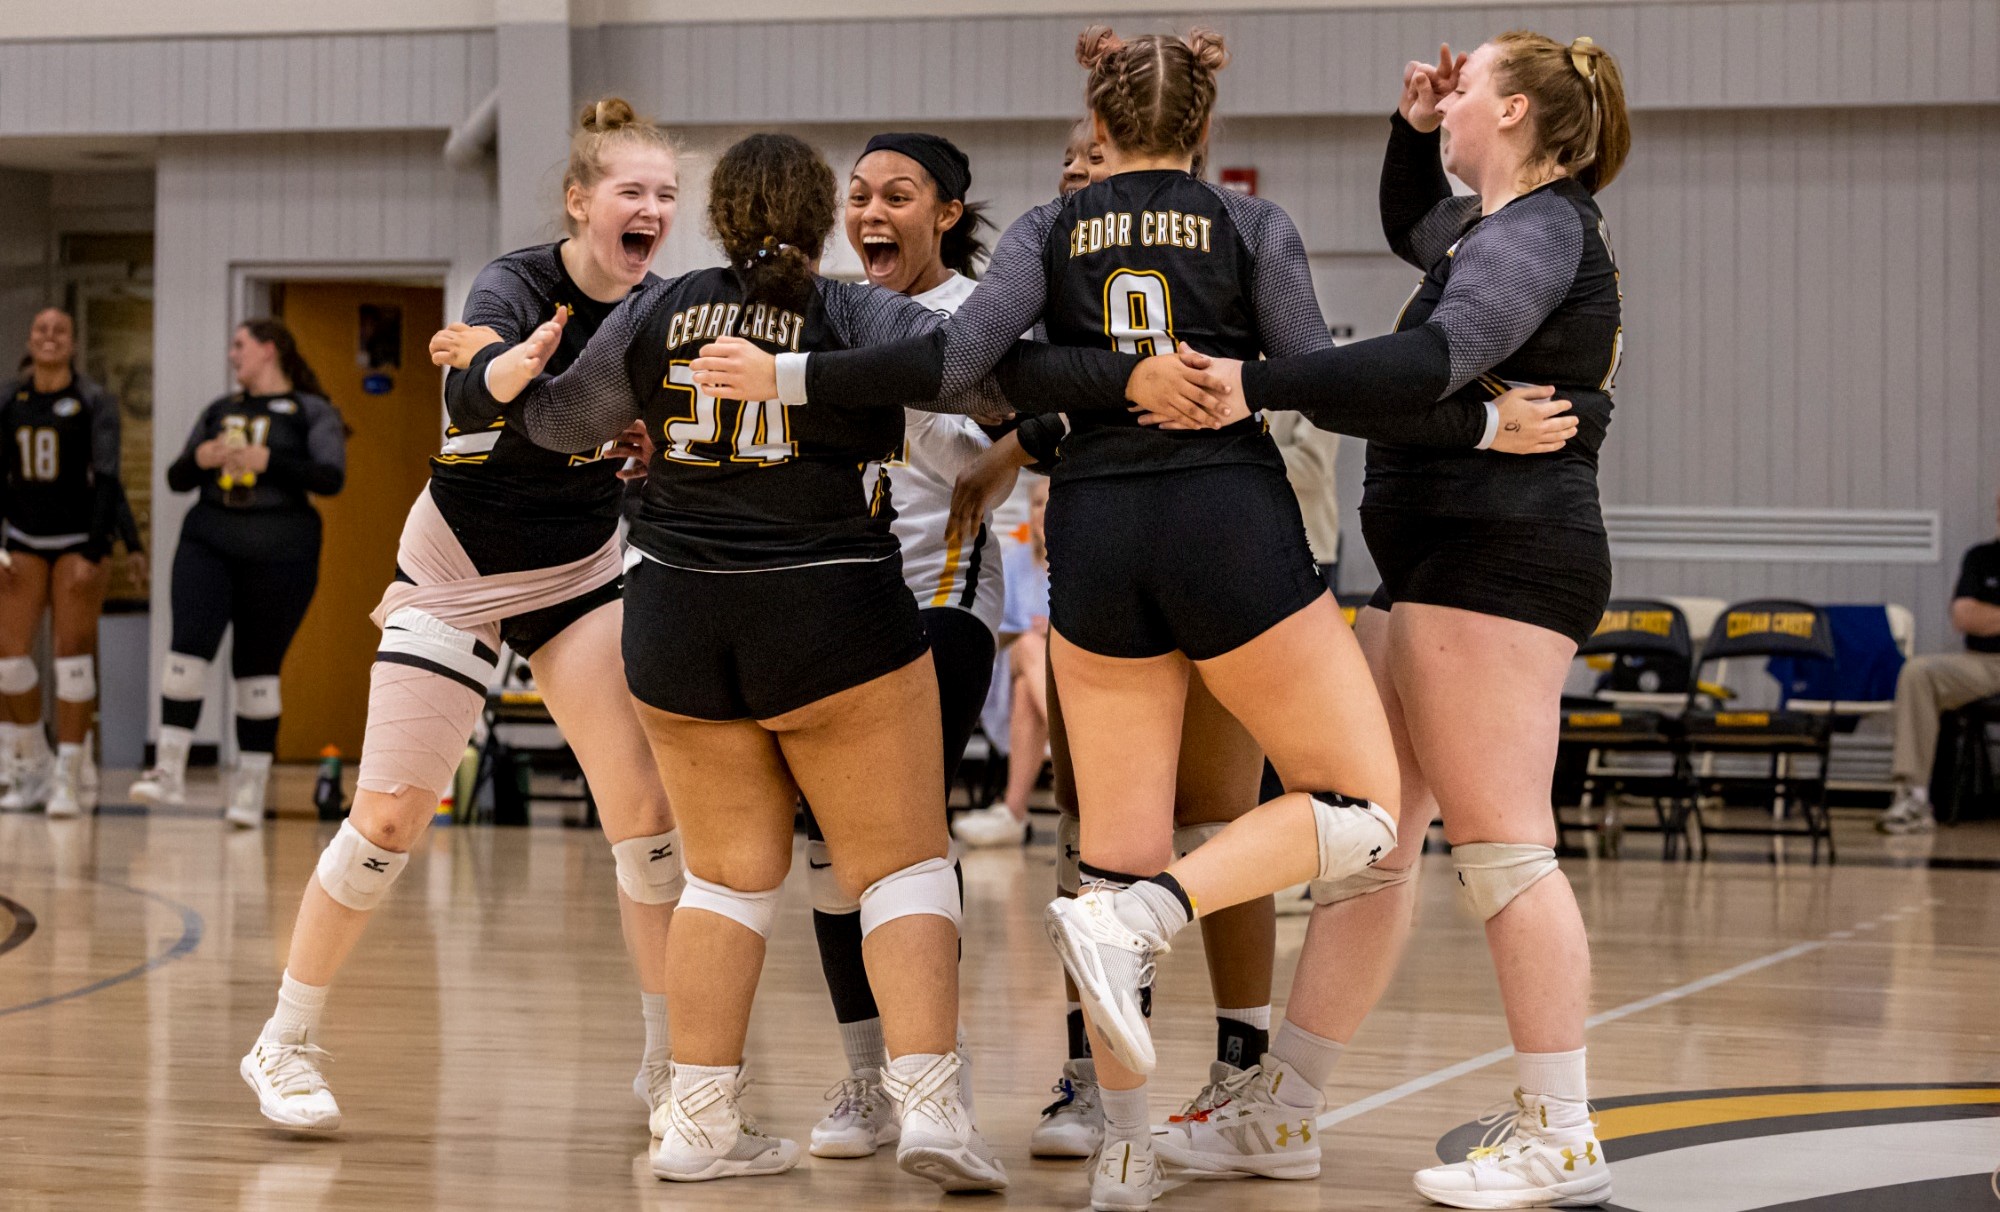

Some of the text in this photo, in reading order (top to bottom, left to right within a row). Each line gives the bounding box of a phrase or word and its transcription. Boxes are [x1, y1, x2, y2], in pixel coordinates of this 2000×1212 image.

[1141, 210, 1211, 252] CREST
[667, 301, 804, 352] CEDAR CREST
[16, 425, 59, 482] 18
